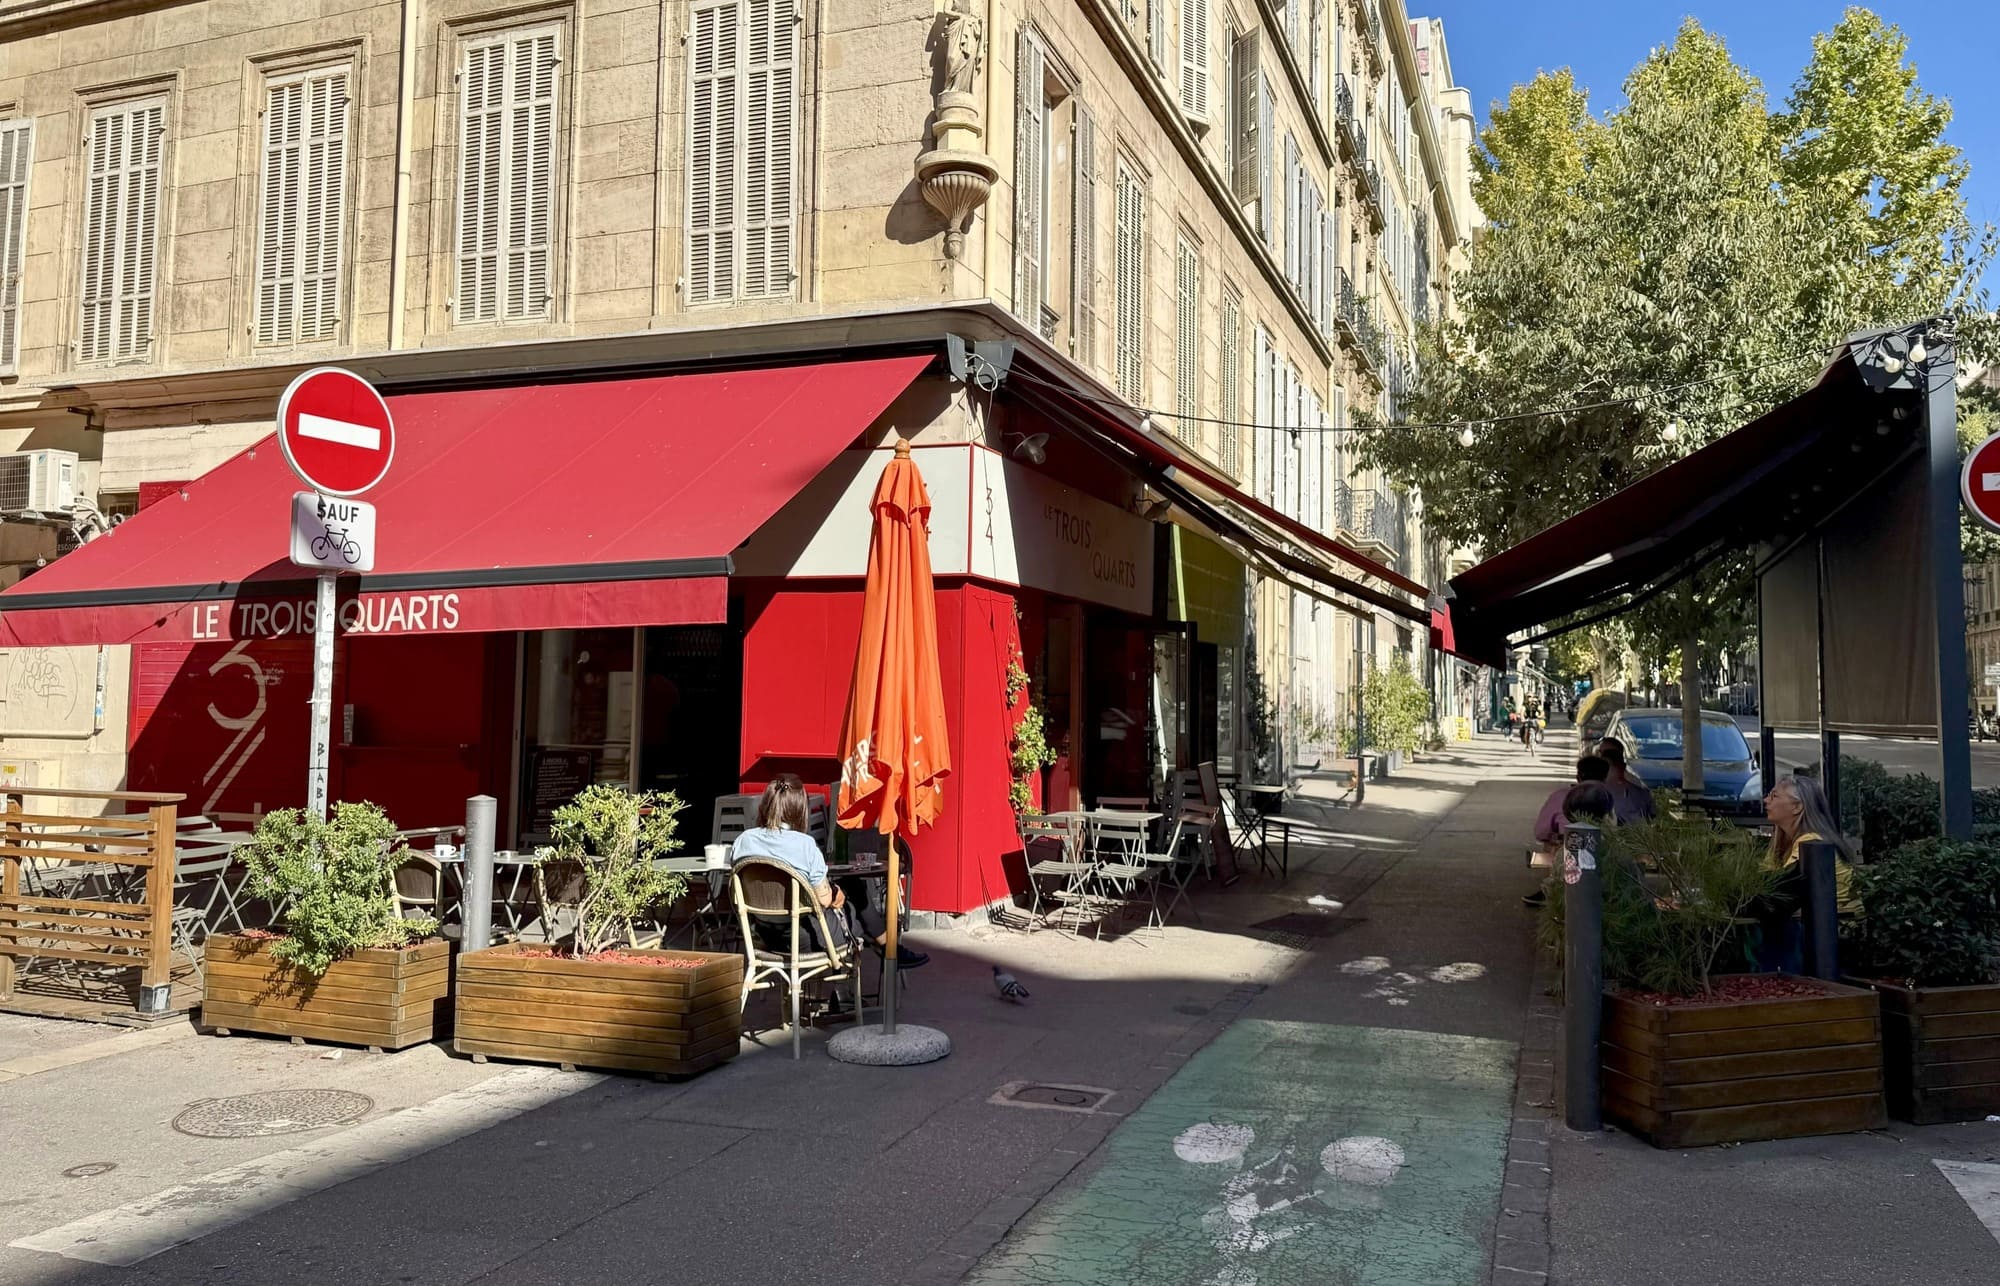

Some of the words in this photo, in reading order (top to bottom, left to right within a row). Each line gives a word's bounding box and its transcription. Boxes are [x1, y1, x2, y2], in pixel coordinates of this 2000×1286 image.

[316, 503, 360, 523] SAUF
[1044, 503, 1056, 520] LE
[1054, 508, 1092, 549] TROIS
[1092, 551, 1136, 589] QUARTS
[192, 605, 220, 639] LE
[239, 600, 317, 636] TROIS
[339, 593, 460, 633] QUARTS
